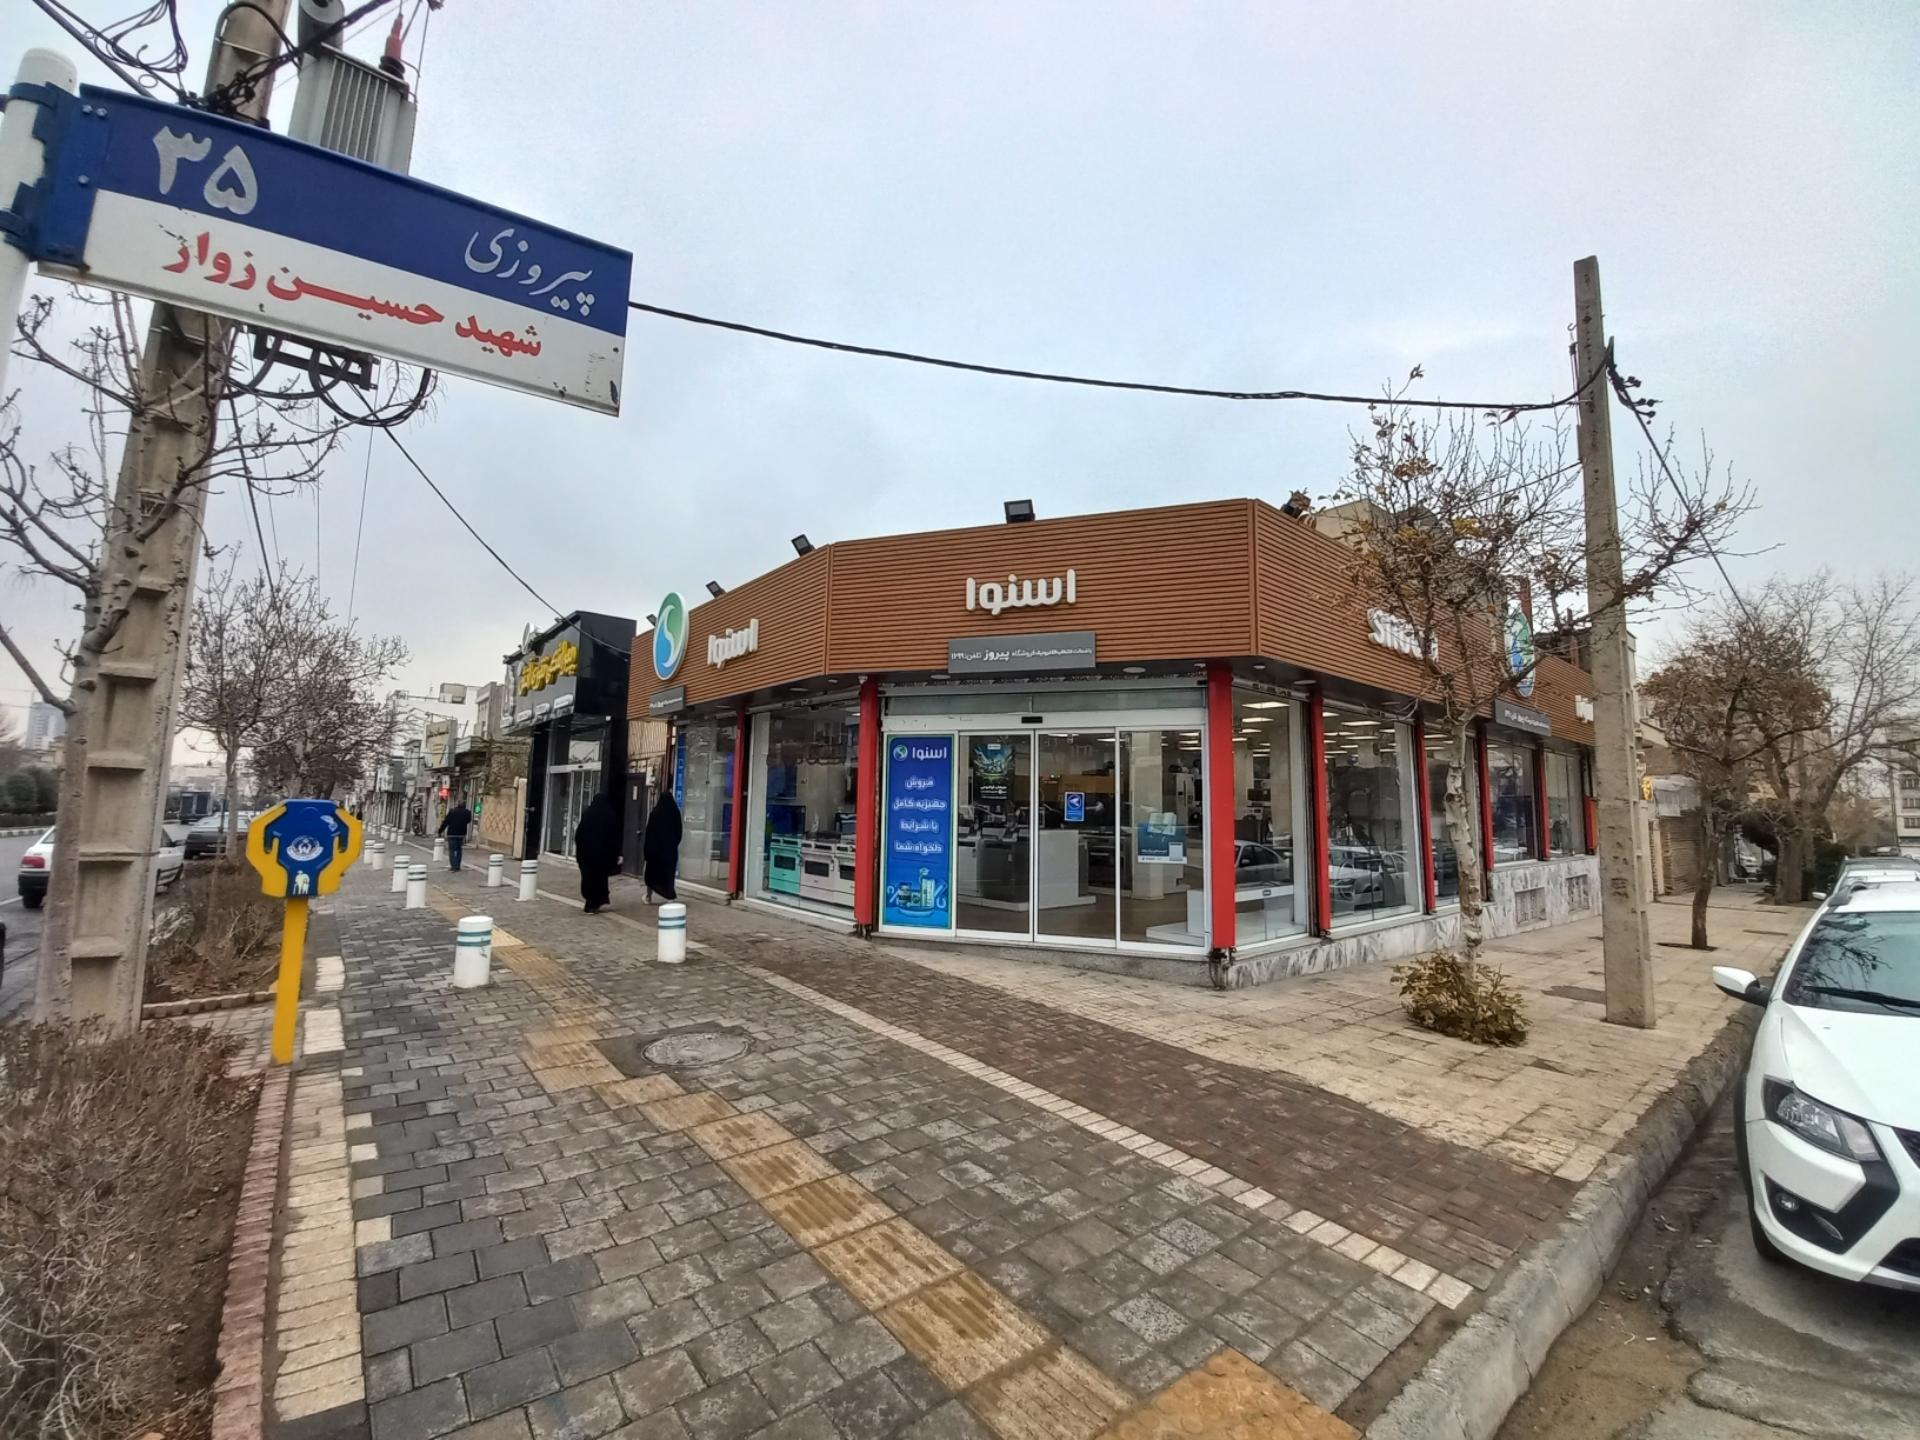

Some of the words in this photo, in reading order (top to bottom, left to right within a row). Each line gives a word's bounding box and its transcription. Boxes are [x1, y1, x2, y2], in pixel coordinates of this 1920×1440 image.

[153, 126, 258, 215] ۳۵
[162, 231, 257, 290] زوار
[464, 228, 595, 316] پیروزی
[267, 266, 445, 325] حسین
[455, 315, 541, 357] شهید
[966, 568, 1076, 615] اسنوا
[707, 618, 759, 669] اسنوا
[983, 649, 1010, 662] پیروز
[912, 746, 947, 760] اسنوا
[893, 799, 914, 809] کامل
[906, 776, 934, 789] فروش
